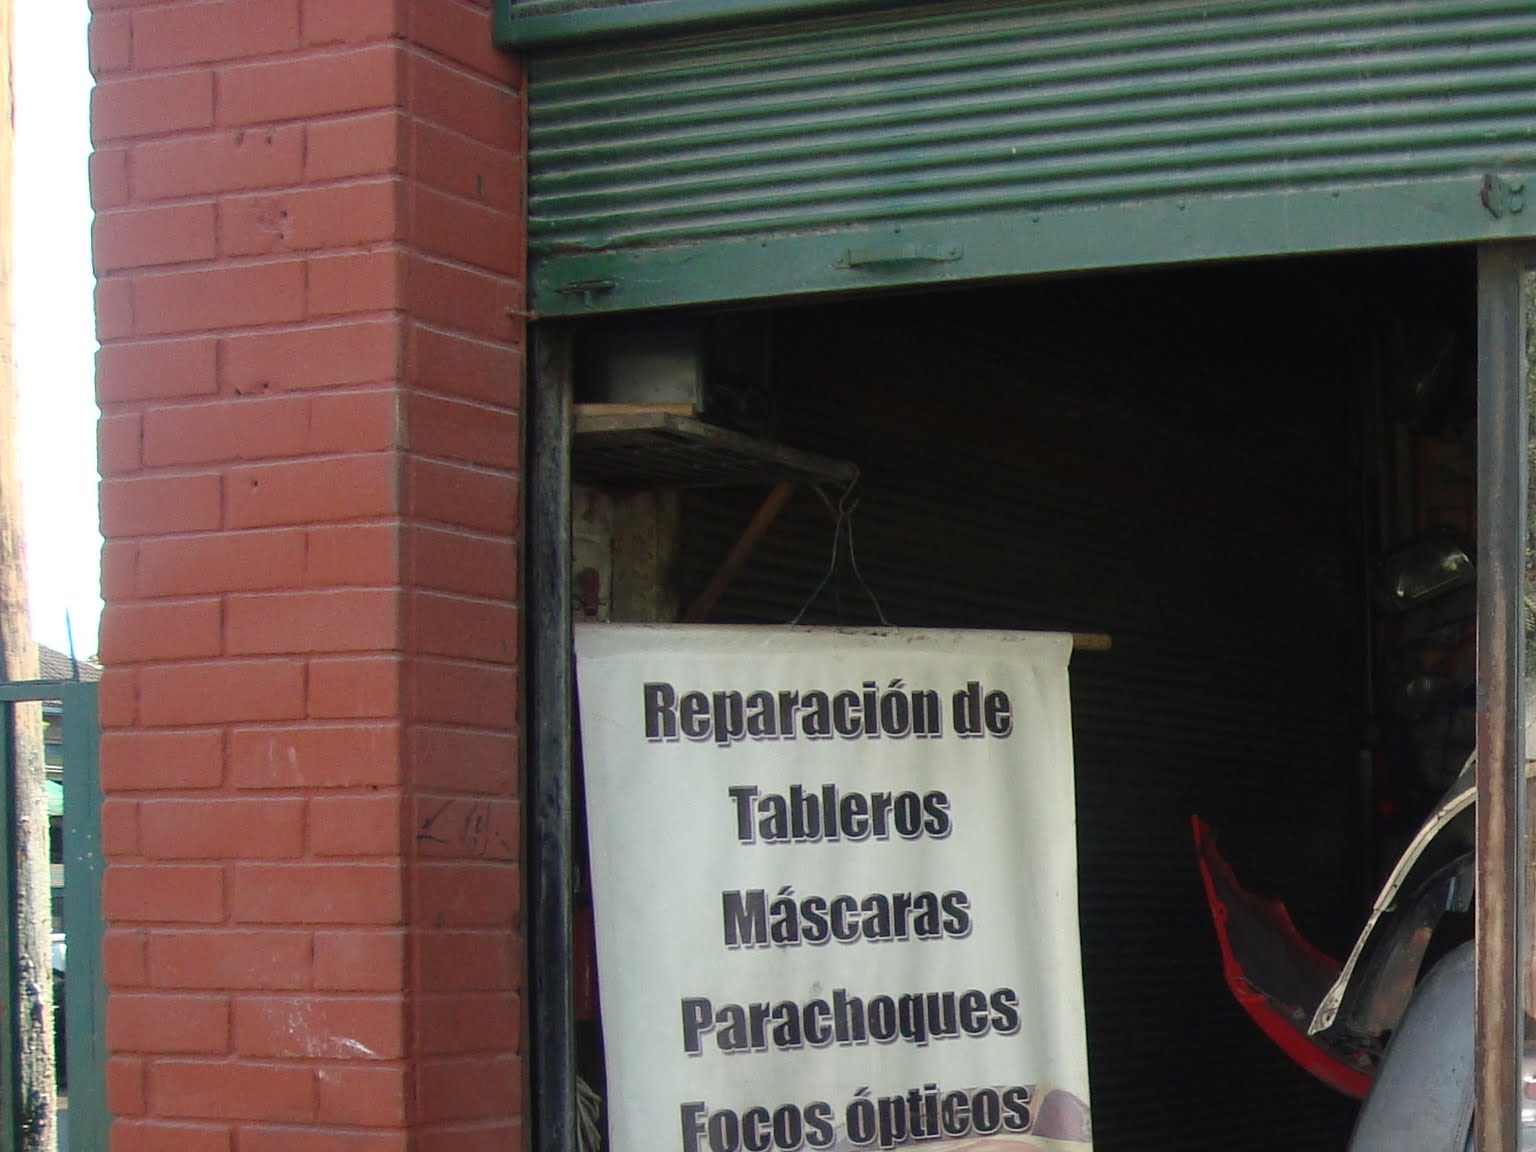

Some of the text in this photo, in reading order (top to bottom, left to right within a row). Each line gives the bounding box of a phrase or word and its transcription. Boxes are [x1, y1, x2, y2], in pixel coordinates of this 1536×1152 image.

[643, 679, 1014, 745] Reparación de
[728, 784, 952, 844] Tableros
[721, 886, 973, 949] Máscaras
[681, 986, 1021, 1056] Parachoques
[845, 1083, 1034, 1149] ópticos
